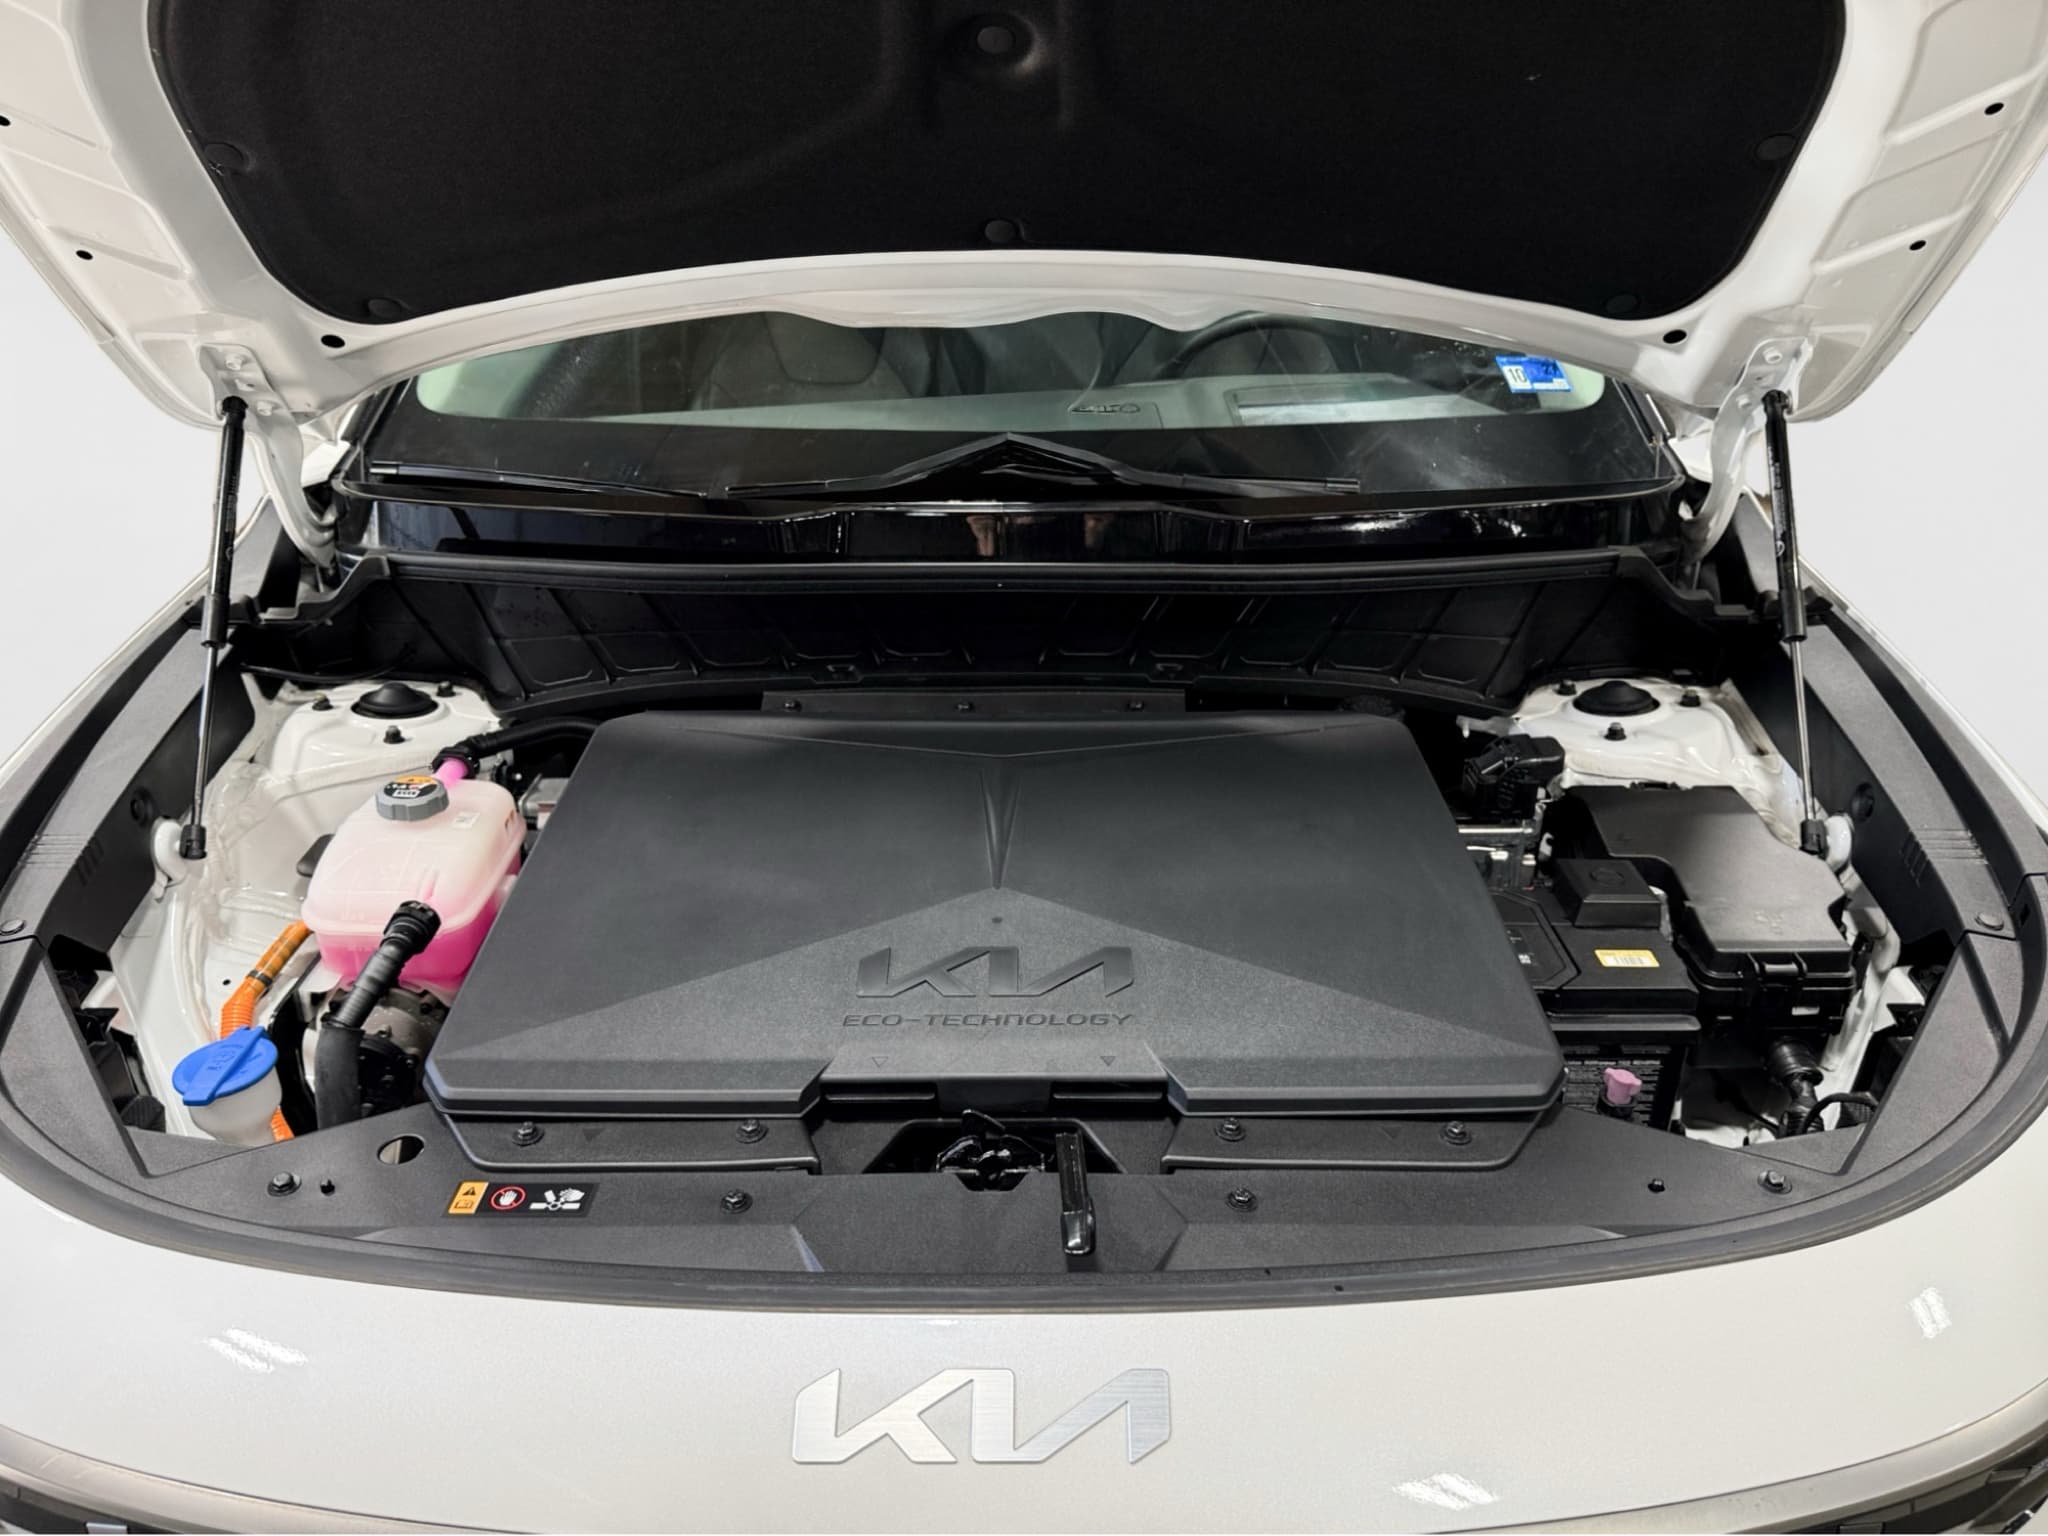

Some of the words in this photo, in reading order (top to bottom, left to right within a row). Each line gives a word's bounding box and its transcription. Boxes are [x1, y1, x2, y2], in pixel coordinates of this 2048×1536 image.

[1508, 368, 1527, 383] 10
[856, 946, 1134, 998] KIA
[843, 1013, 1133, 1027] ECO-TECHNOLOGY
[793, 1368, 1171, 1464] KIA
